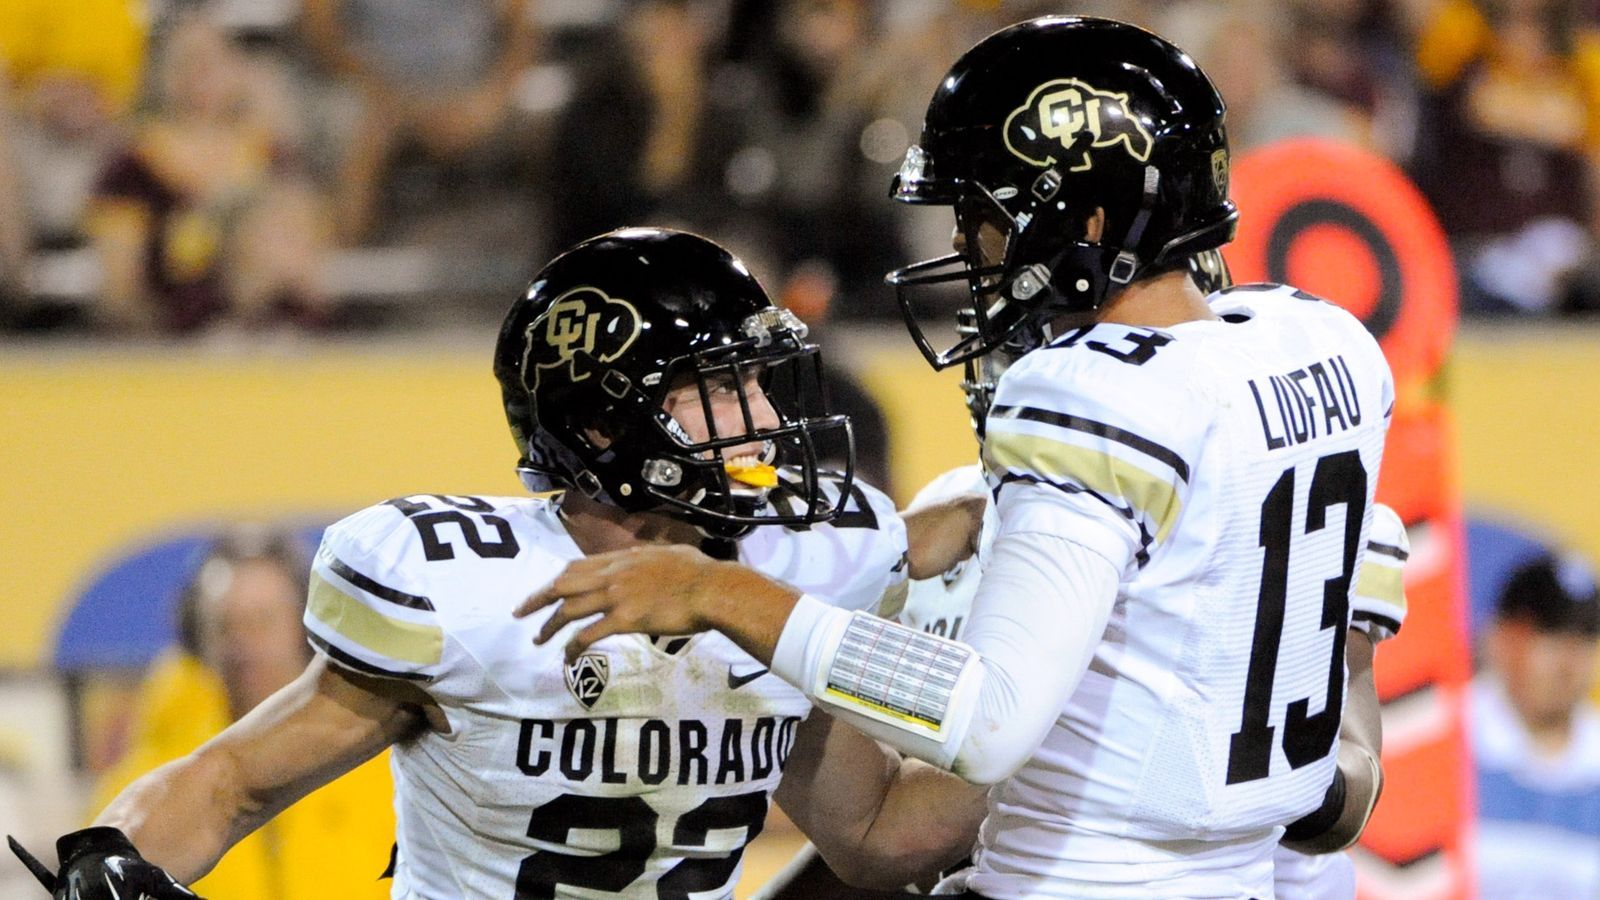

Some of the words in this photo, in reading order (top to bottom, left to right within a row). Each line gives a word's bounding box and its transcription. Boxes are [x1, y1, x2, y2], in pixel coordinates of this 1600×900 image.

[1248, 355, 1362, 450] LIUFAU
[379, 494, 521, 562] 22
[1225, 449, 1369, 786] 13
[578, 676, 601, 700] 12
[515, 716, 802, 786] COLORADO
[513, 789, 769, 900] 22
